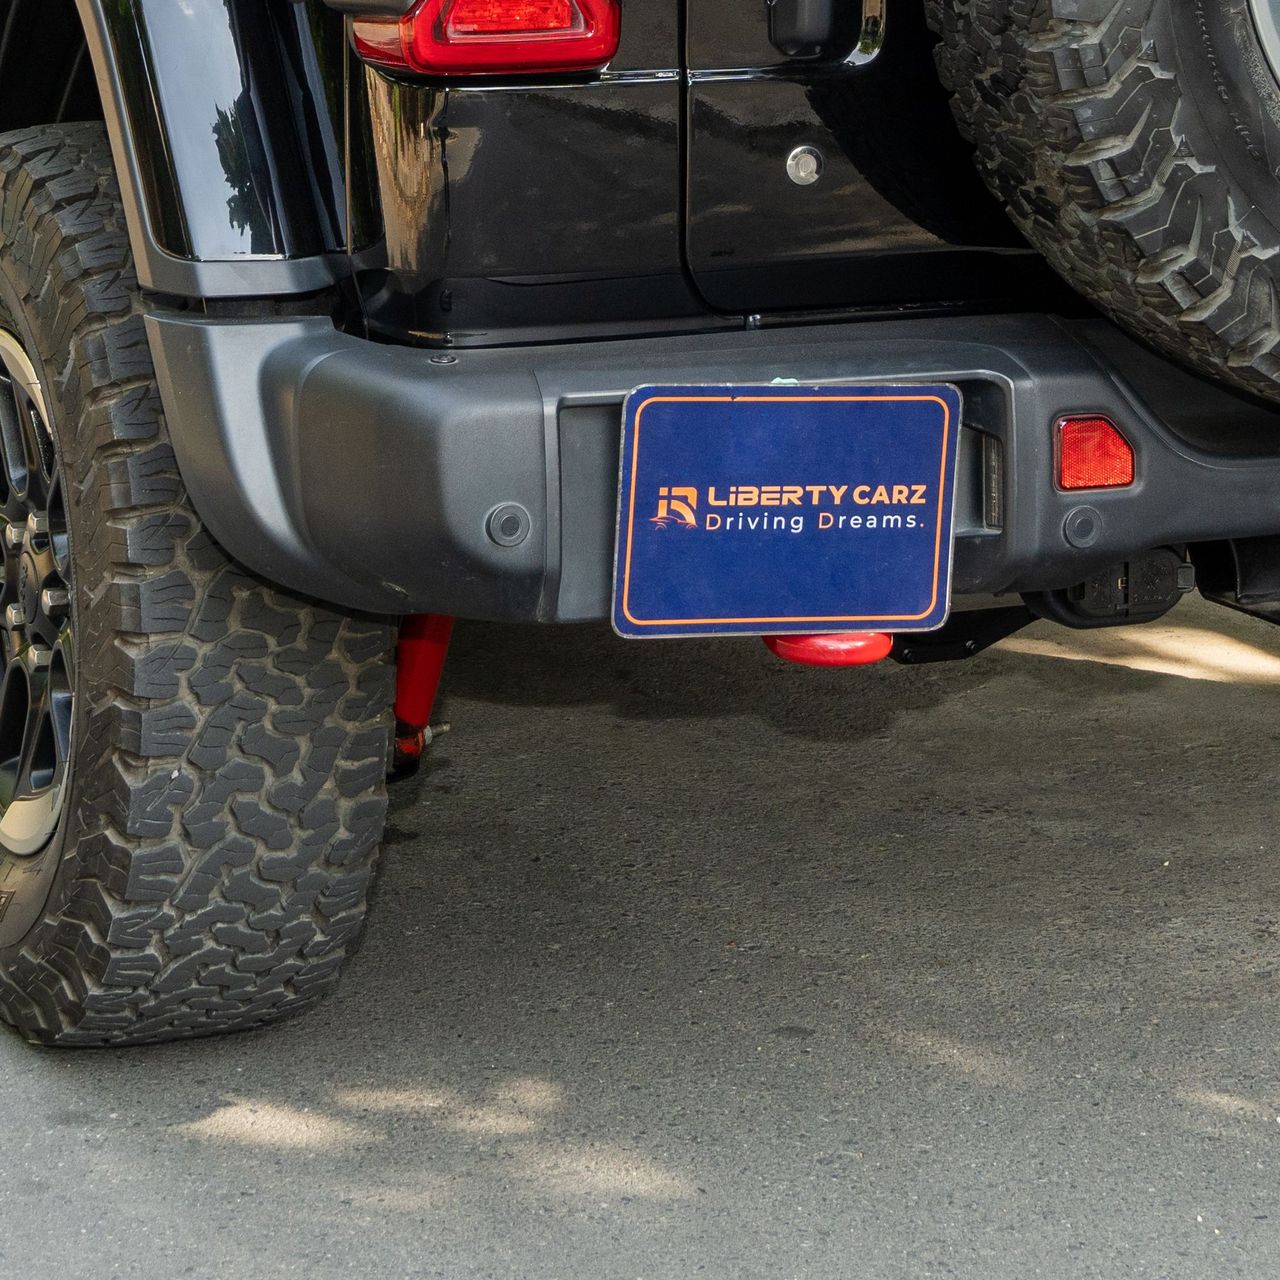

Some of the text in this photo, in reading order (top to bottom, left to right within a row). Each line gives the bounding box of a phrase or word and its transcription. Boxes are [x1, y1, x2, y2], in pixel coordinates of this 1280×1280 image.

[852, 484, 928, 505] CARZ
[705, 511, 926, 534] Driving Dreams.
